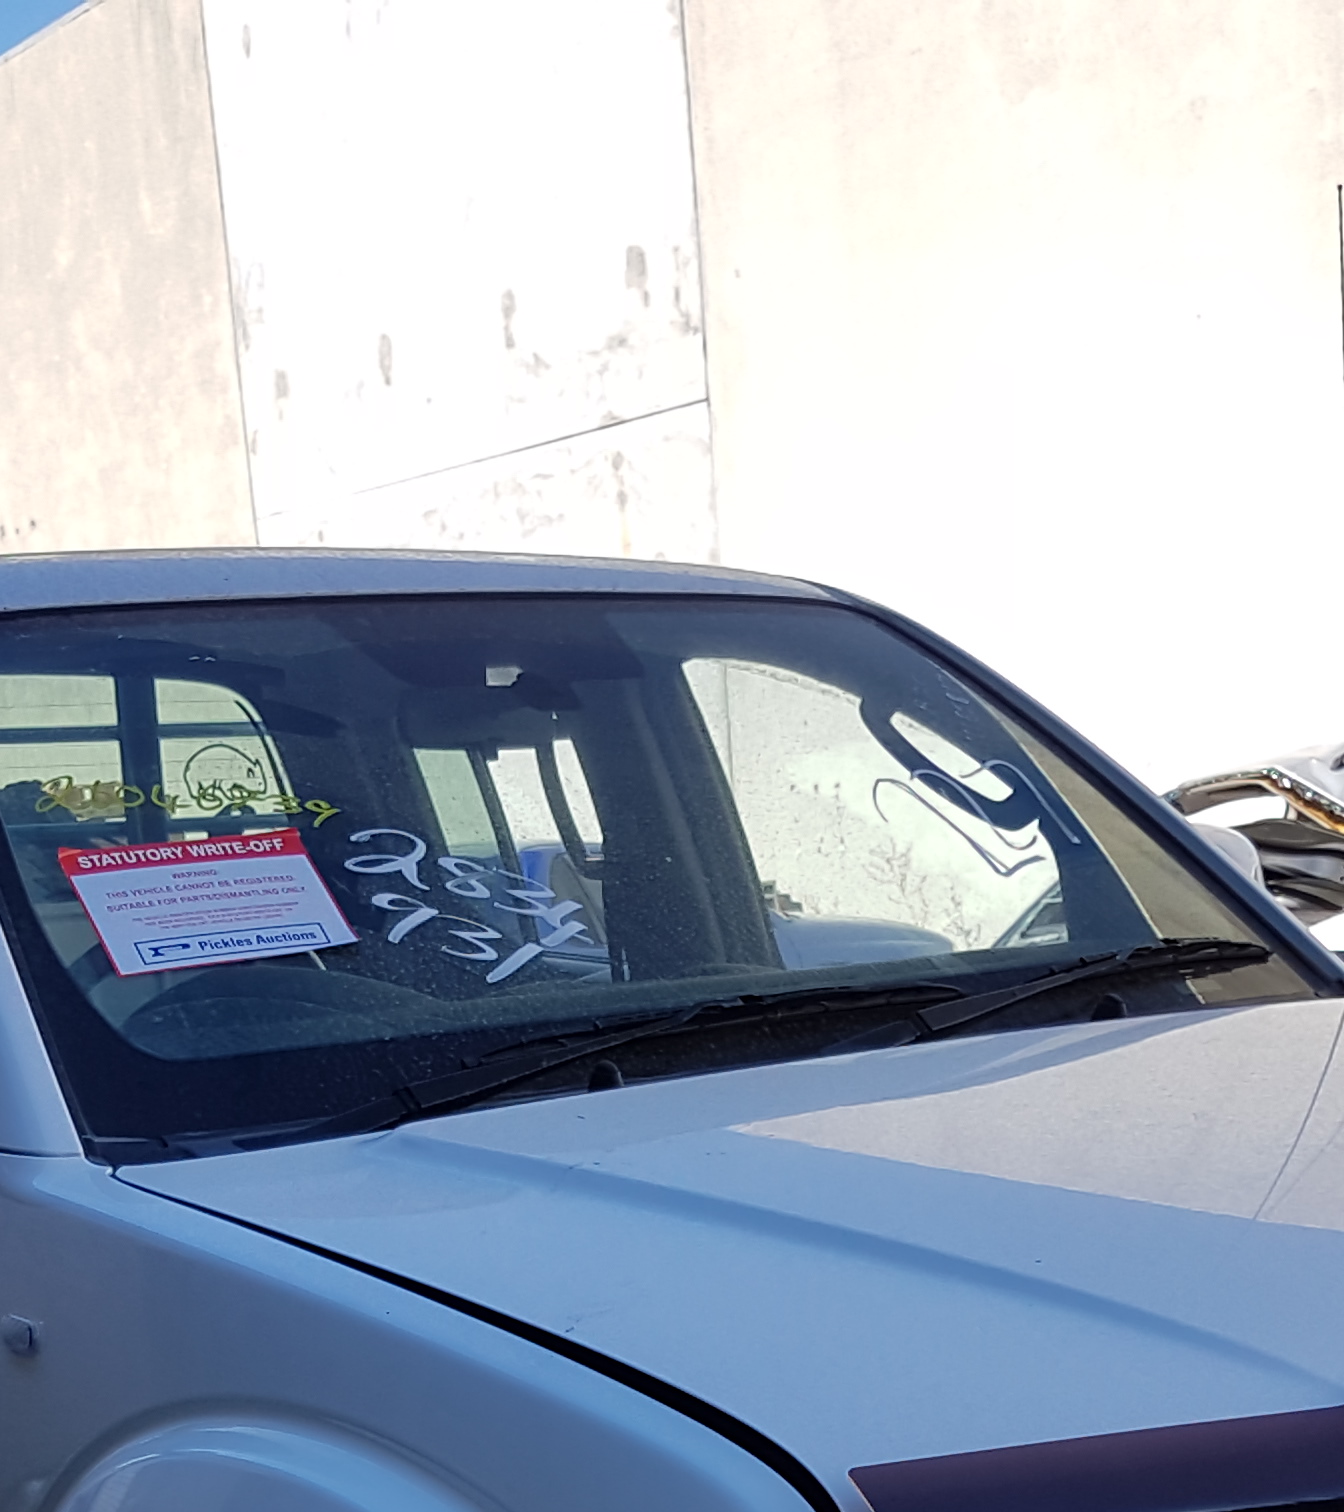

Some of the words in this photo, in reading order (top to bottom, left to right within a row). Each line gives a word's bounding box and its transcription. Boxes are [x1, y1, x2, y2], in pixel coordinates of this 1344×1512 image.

[77, 845, 183, 869] STATUTORY
[186, 838, 284, 858] WRITE-OFF
[106, 891, 129, 899] THIS
[131, 886, 174, 898] VEHICLE
[175, 881, 215, 892] CANNOT
[218, 880, 233, 888] BE
[157, 897, 178, 906] FOR
[198, 938, 253, 951] Pickles
[256, 930, 318, 946] Auctions
